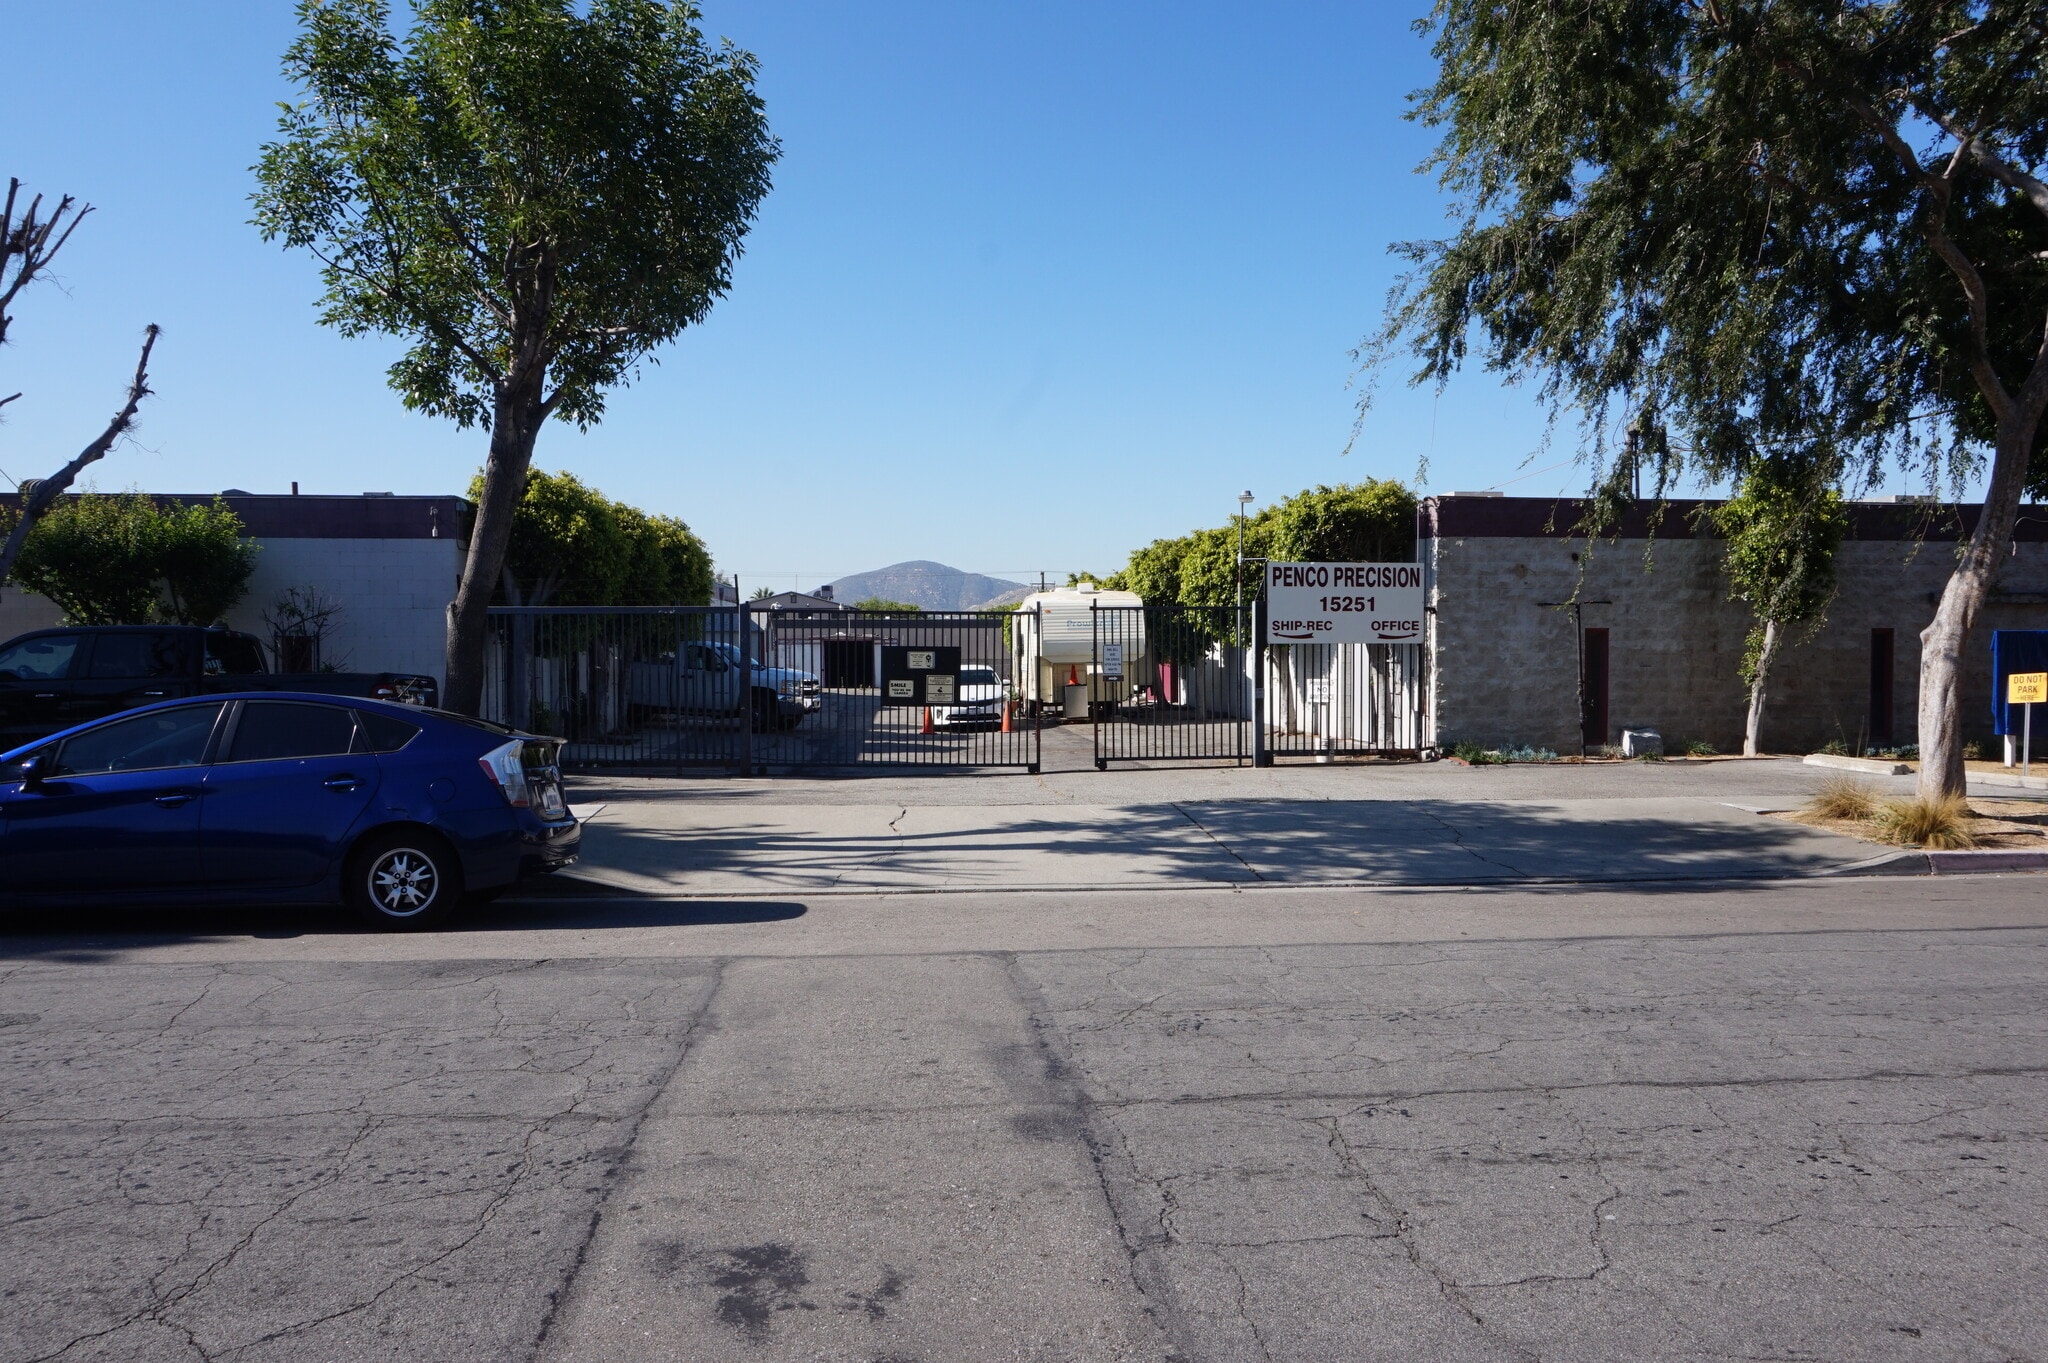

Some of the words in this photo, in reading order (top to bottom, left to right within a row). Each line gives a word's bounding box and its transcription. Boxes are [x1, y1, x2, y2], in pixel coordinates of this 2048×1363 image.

[1272, 566, 1329, 587] PENCO
[1334, 566, 1420, 588] PRECISION
[1319, 596, 1375, 612] 15251
[1272, 620, 1333, 631] SHIP-REC
[1371, 620, 1420, 631] OFFICE
[2013, 676, 2025, 684] DO
[2026, 675, 2043, 683] NOT
[2017, 685, 2038, 694] PARK
